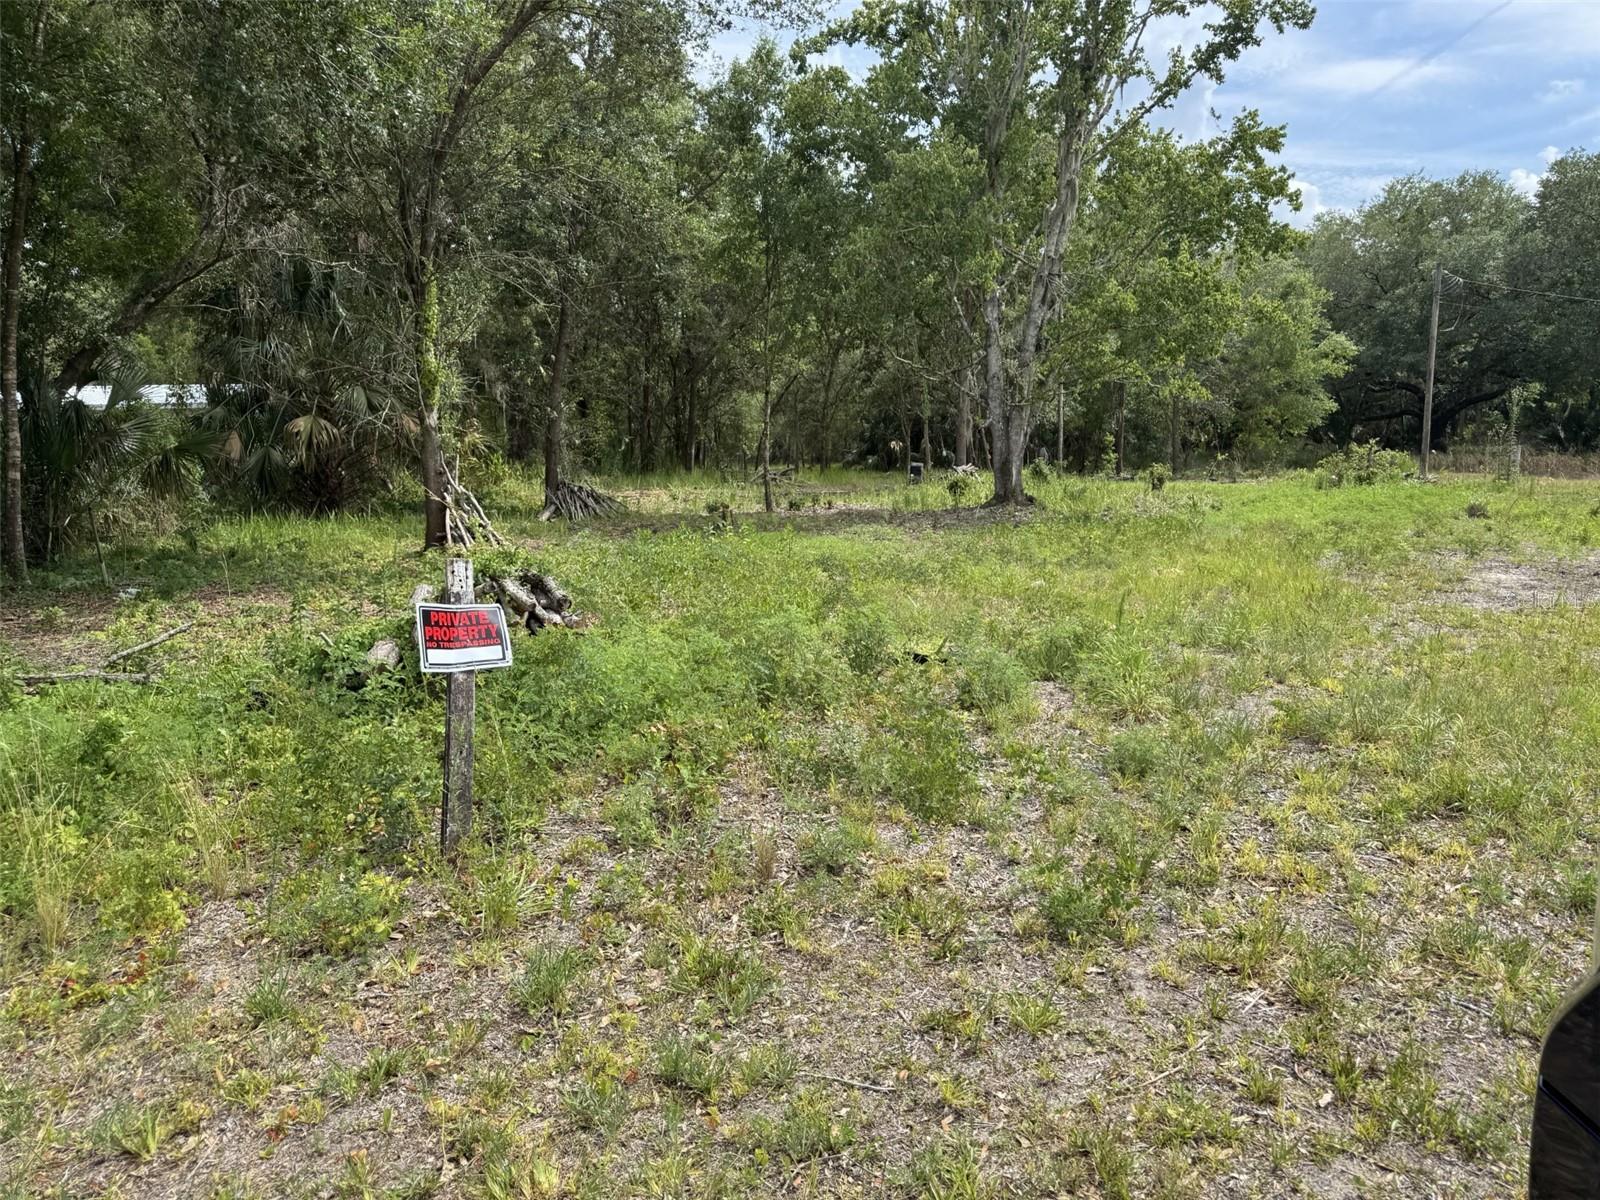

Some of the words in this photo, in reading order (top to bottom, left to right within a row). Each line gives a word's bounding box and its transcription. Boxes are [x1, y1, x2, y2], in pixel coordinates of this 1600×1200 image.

[430, 611, 489, 626] PRIVATE
[425, 624, 498, 641] PROPERTY
[439, 638, 501, 648] TRESPASSING
